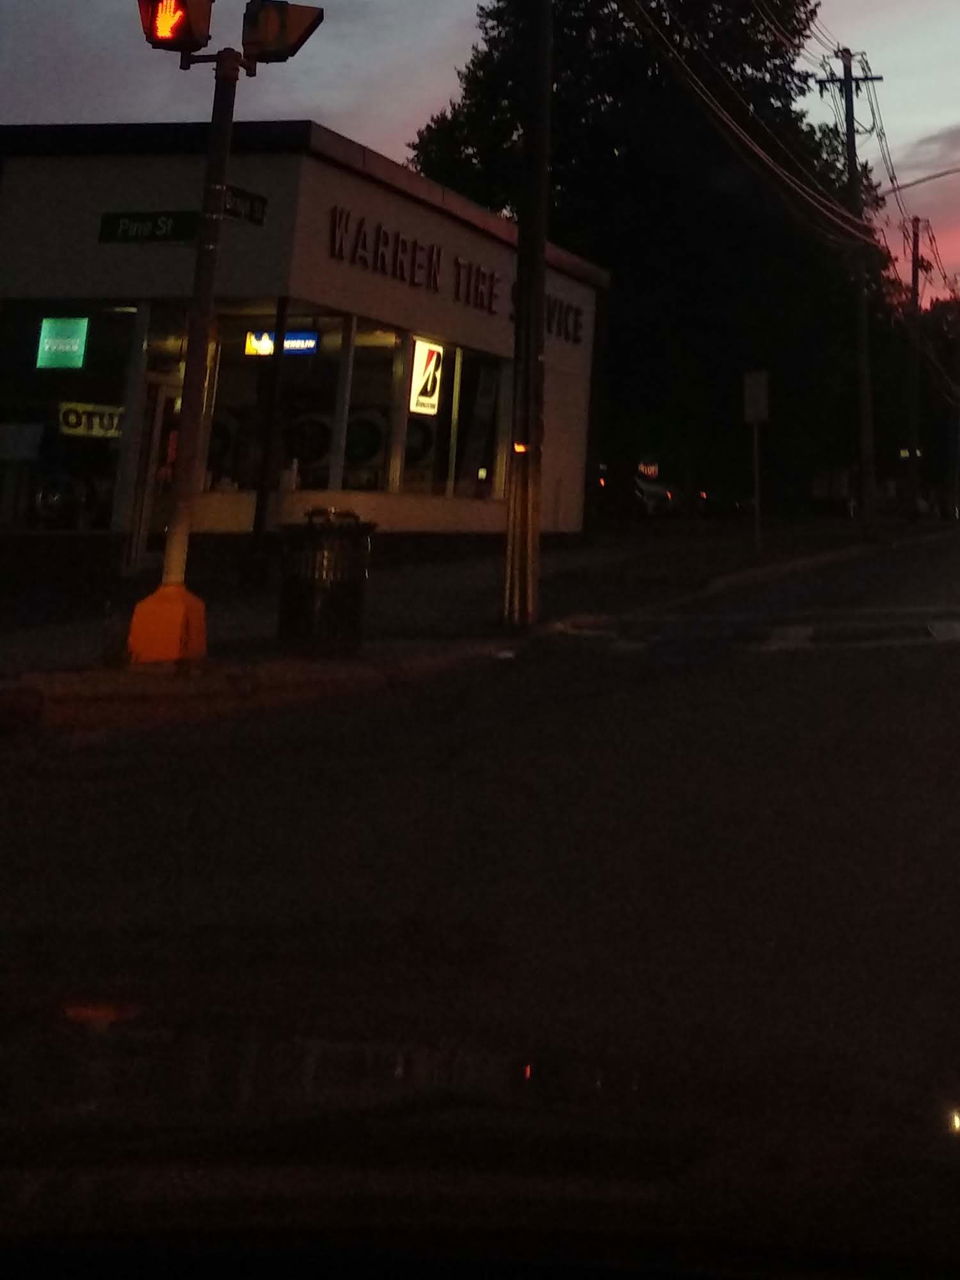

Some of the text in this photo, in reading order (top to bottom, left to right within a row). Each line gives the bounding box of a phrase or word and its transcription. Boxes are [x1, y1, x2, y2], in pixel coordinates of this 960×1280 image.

[155, 215, 175, 236] St
[329, 205, 443, 293] WARREN
[454, 256, 499, 316] TIRE
